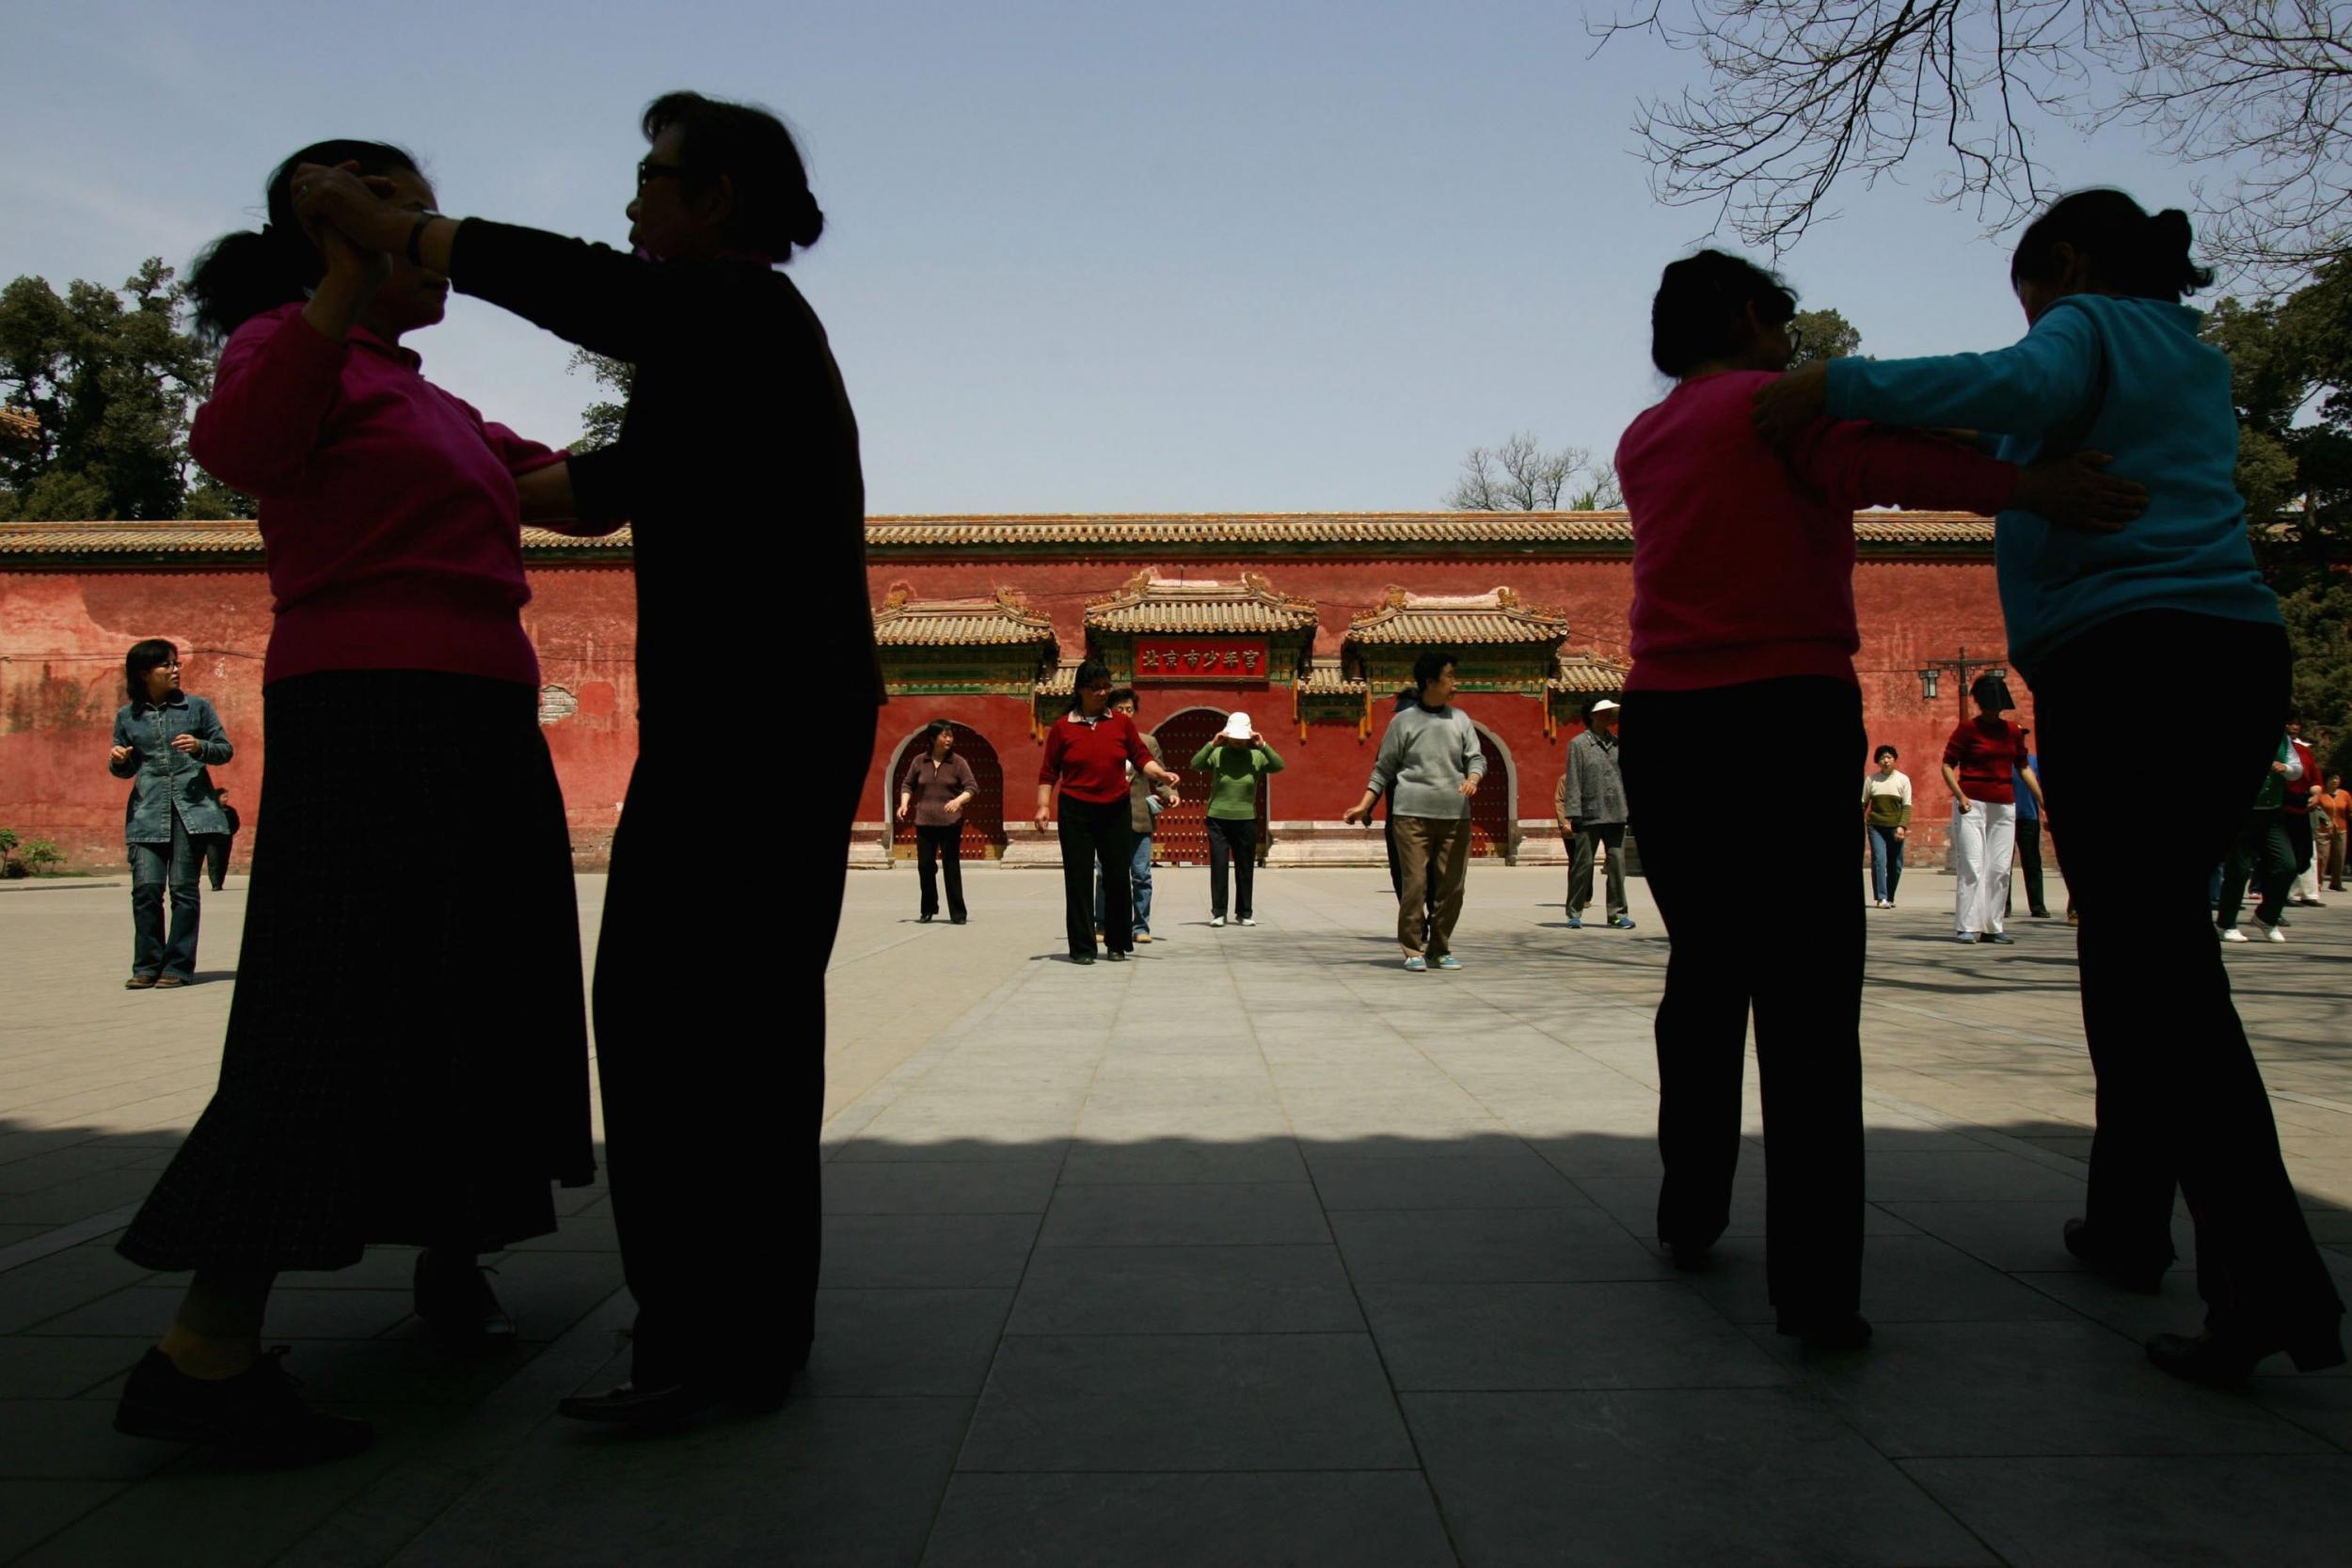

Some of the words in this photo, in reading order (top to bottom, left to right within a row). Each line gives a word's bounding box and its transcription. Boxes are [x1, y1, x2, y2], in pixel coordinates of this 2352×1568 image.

[1142, 649, 1260, 669] 北京市少年宫
